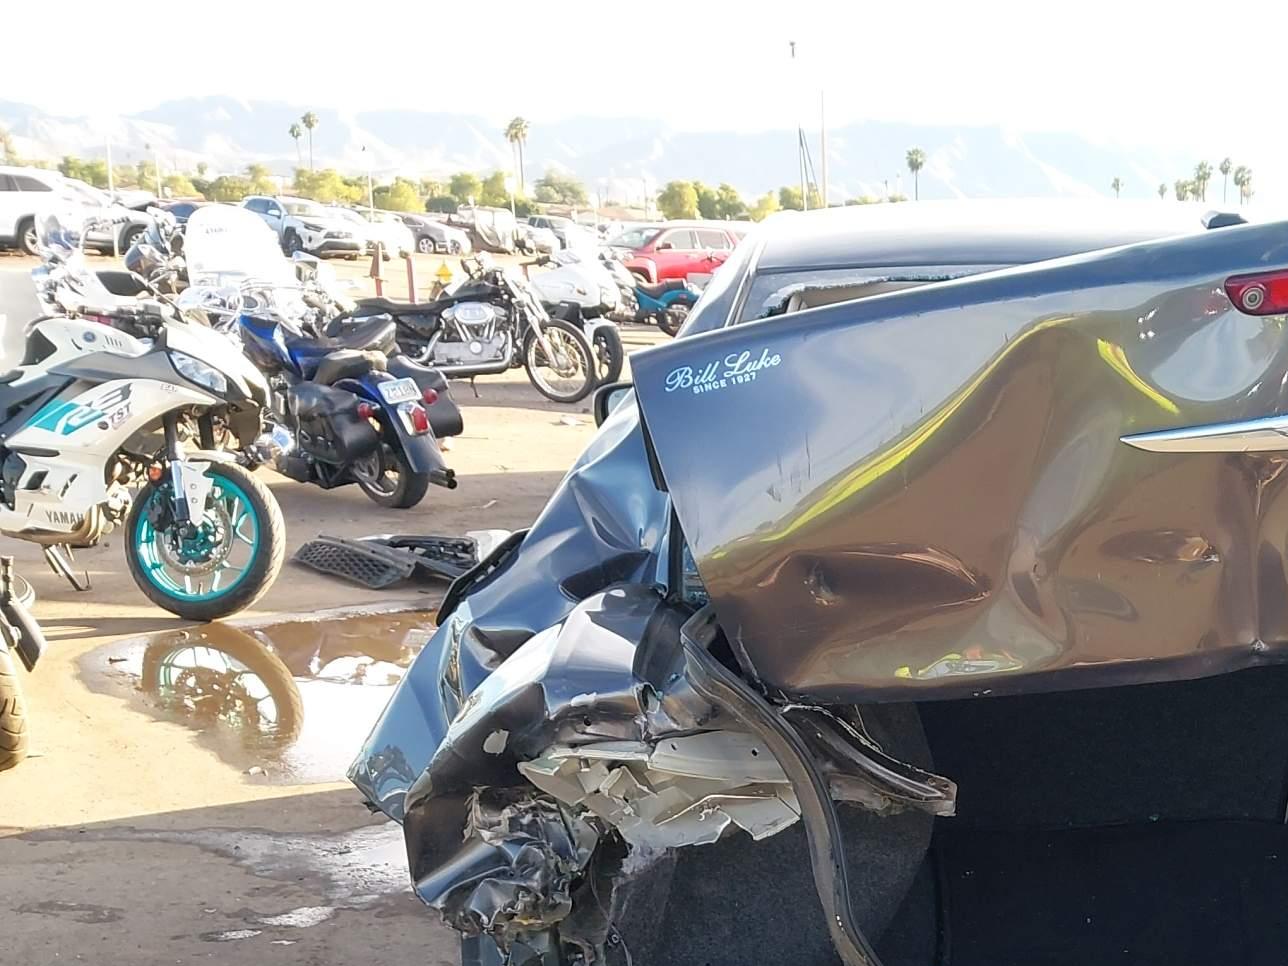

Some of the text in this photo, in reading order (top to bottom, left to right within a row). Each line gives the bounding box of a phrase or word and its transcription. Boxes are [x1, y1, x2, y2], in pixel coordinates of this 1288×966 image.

[665, 348, 782, 392] Bill Luke
[693, 379, 728, 394] SINCE
[45, 511, 84, 524] YAMAH
